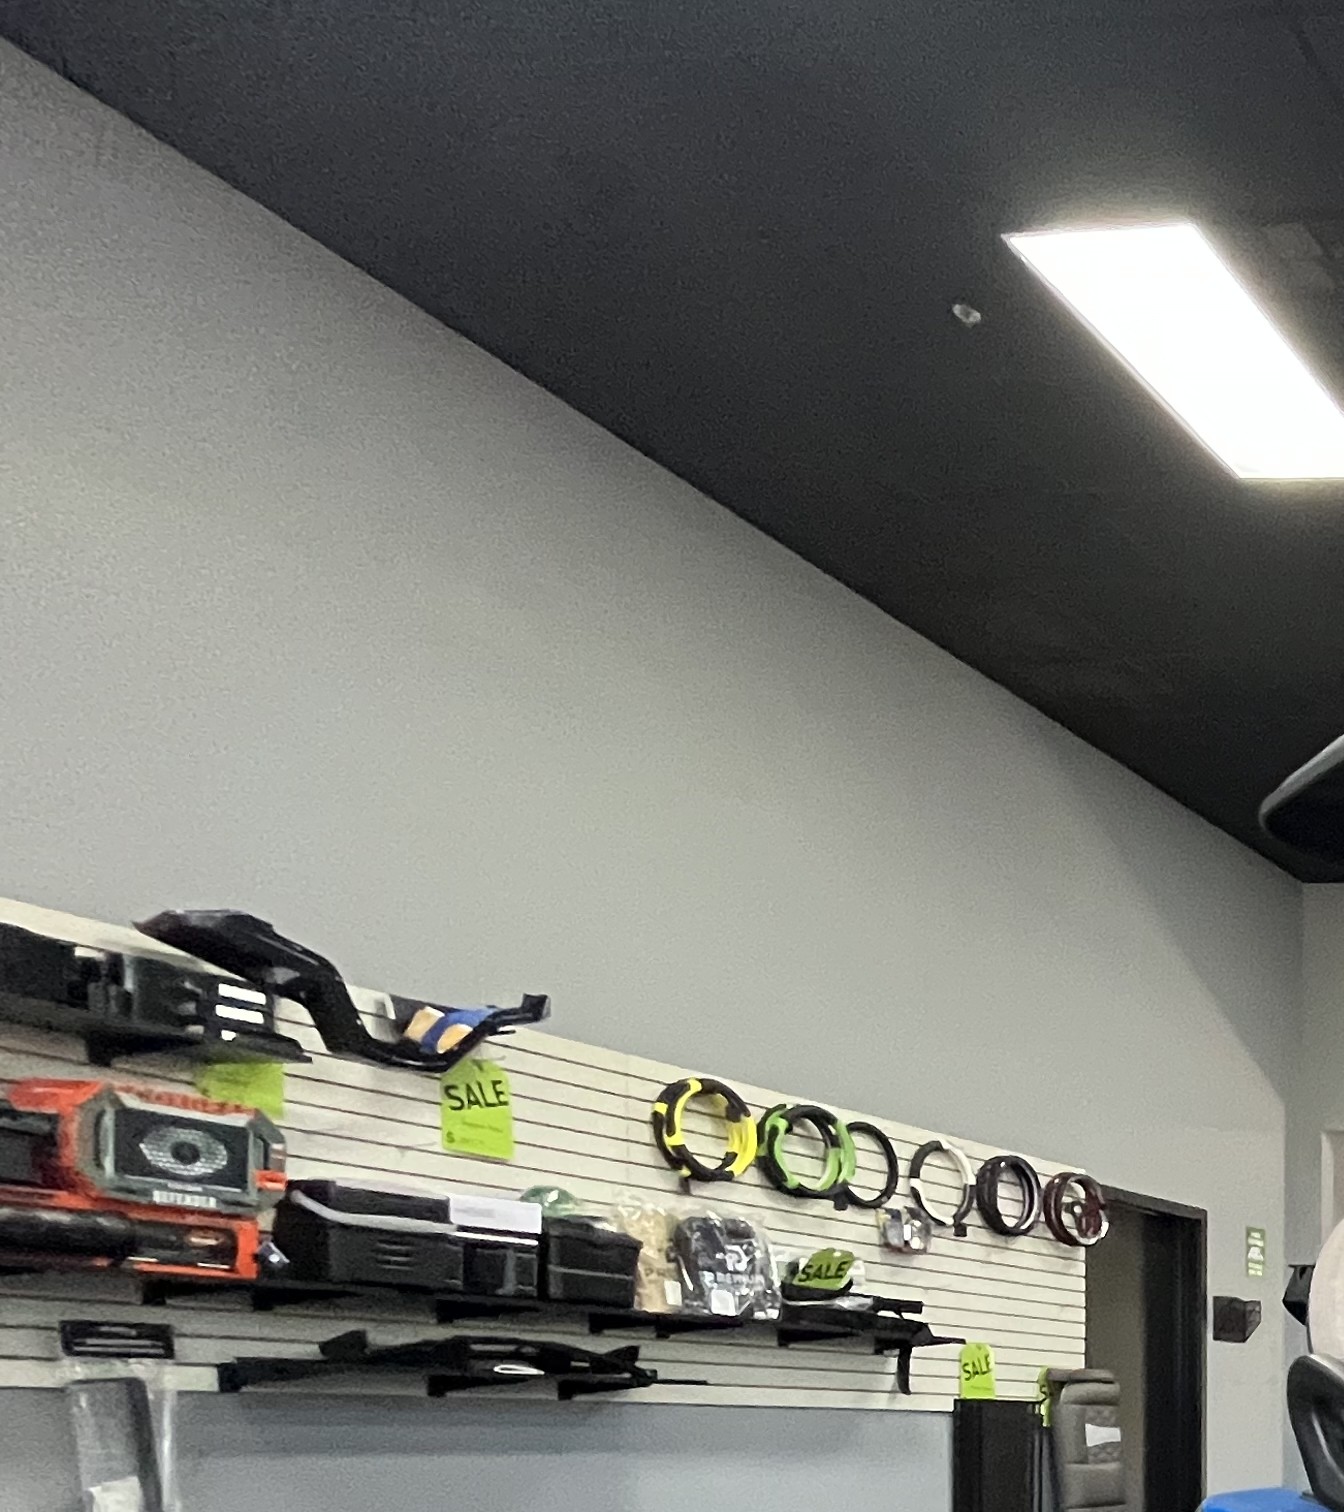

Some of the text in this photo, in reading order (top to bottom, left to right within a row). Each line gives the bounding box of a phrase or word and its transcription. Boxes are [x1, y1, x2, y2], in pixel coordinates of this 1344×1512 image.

[443, 1079, 509, 1111] SALE
[799, 1260, 849, 1282] SALE
[961, 1353, 992, 1381] SALE
